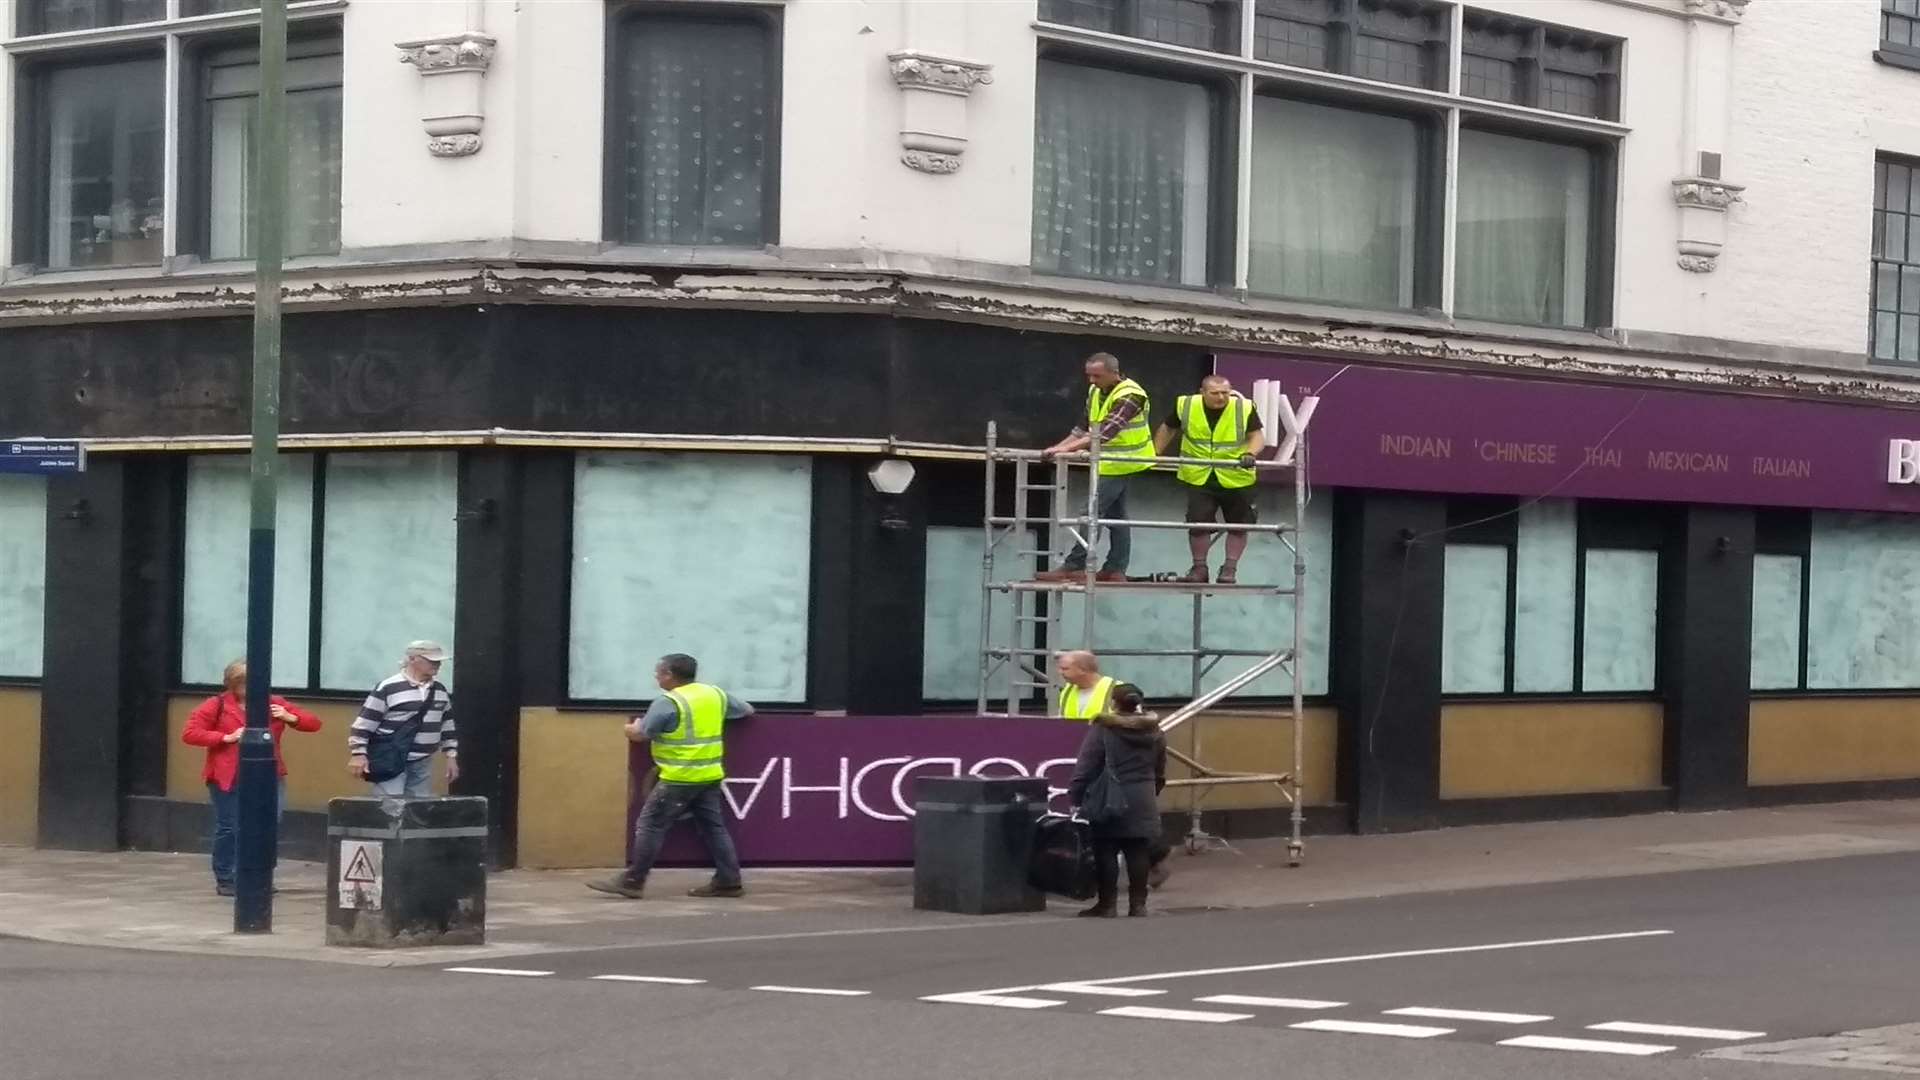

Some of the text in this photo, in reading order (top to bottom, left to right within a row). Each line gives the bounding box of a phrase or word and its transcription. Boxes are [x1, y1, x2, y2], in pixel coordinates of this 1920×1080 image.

[1230, 379, 1320, 463] lly
[1380, 434, 1450, 458] INDIAN
[1583, 447, 1622, 468] THAI
[1648, 450, 1729, 472] MEXICAN
[1752, 457, 1810, 477] ITALIAN
